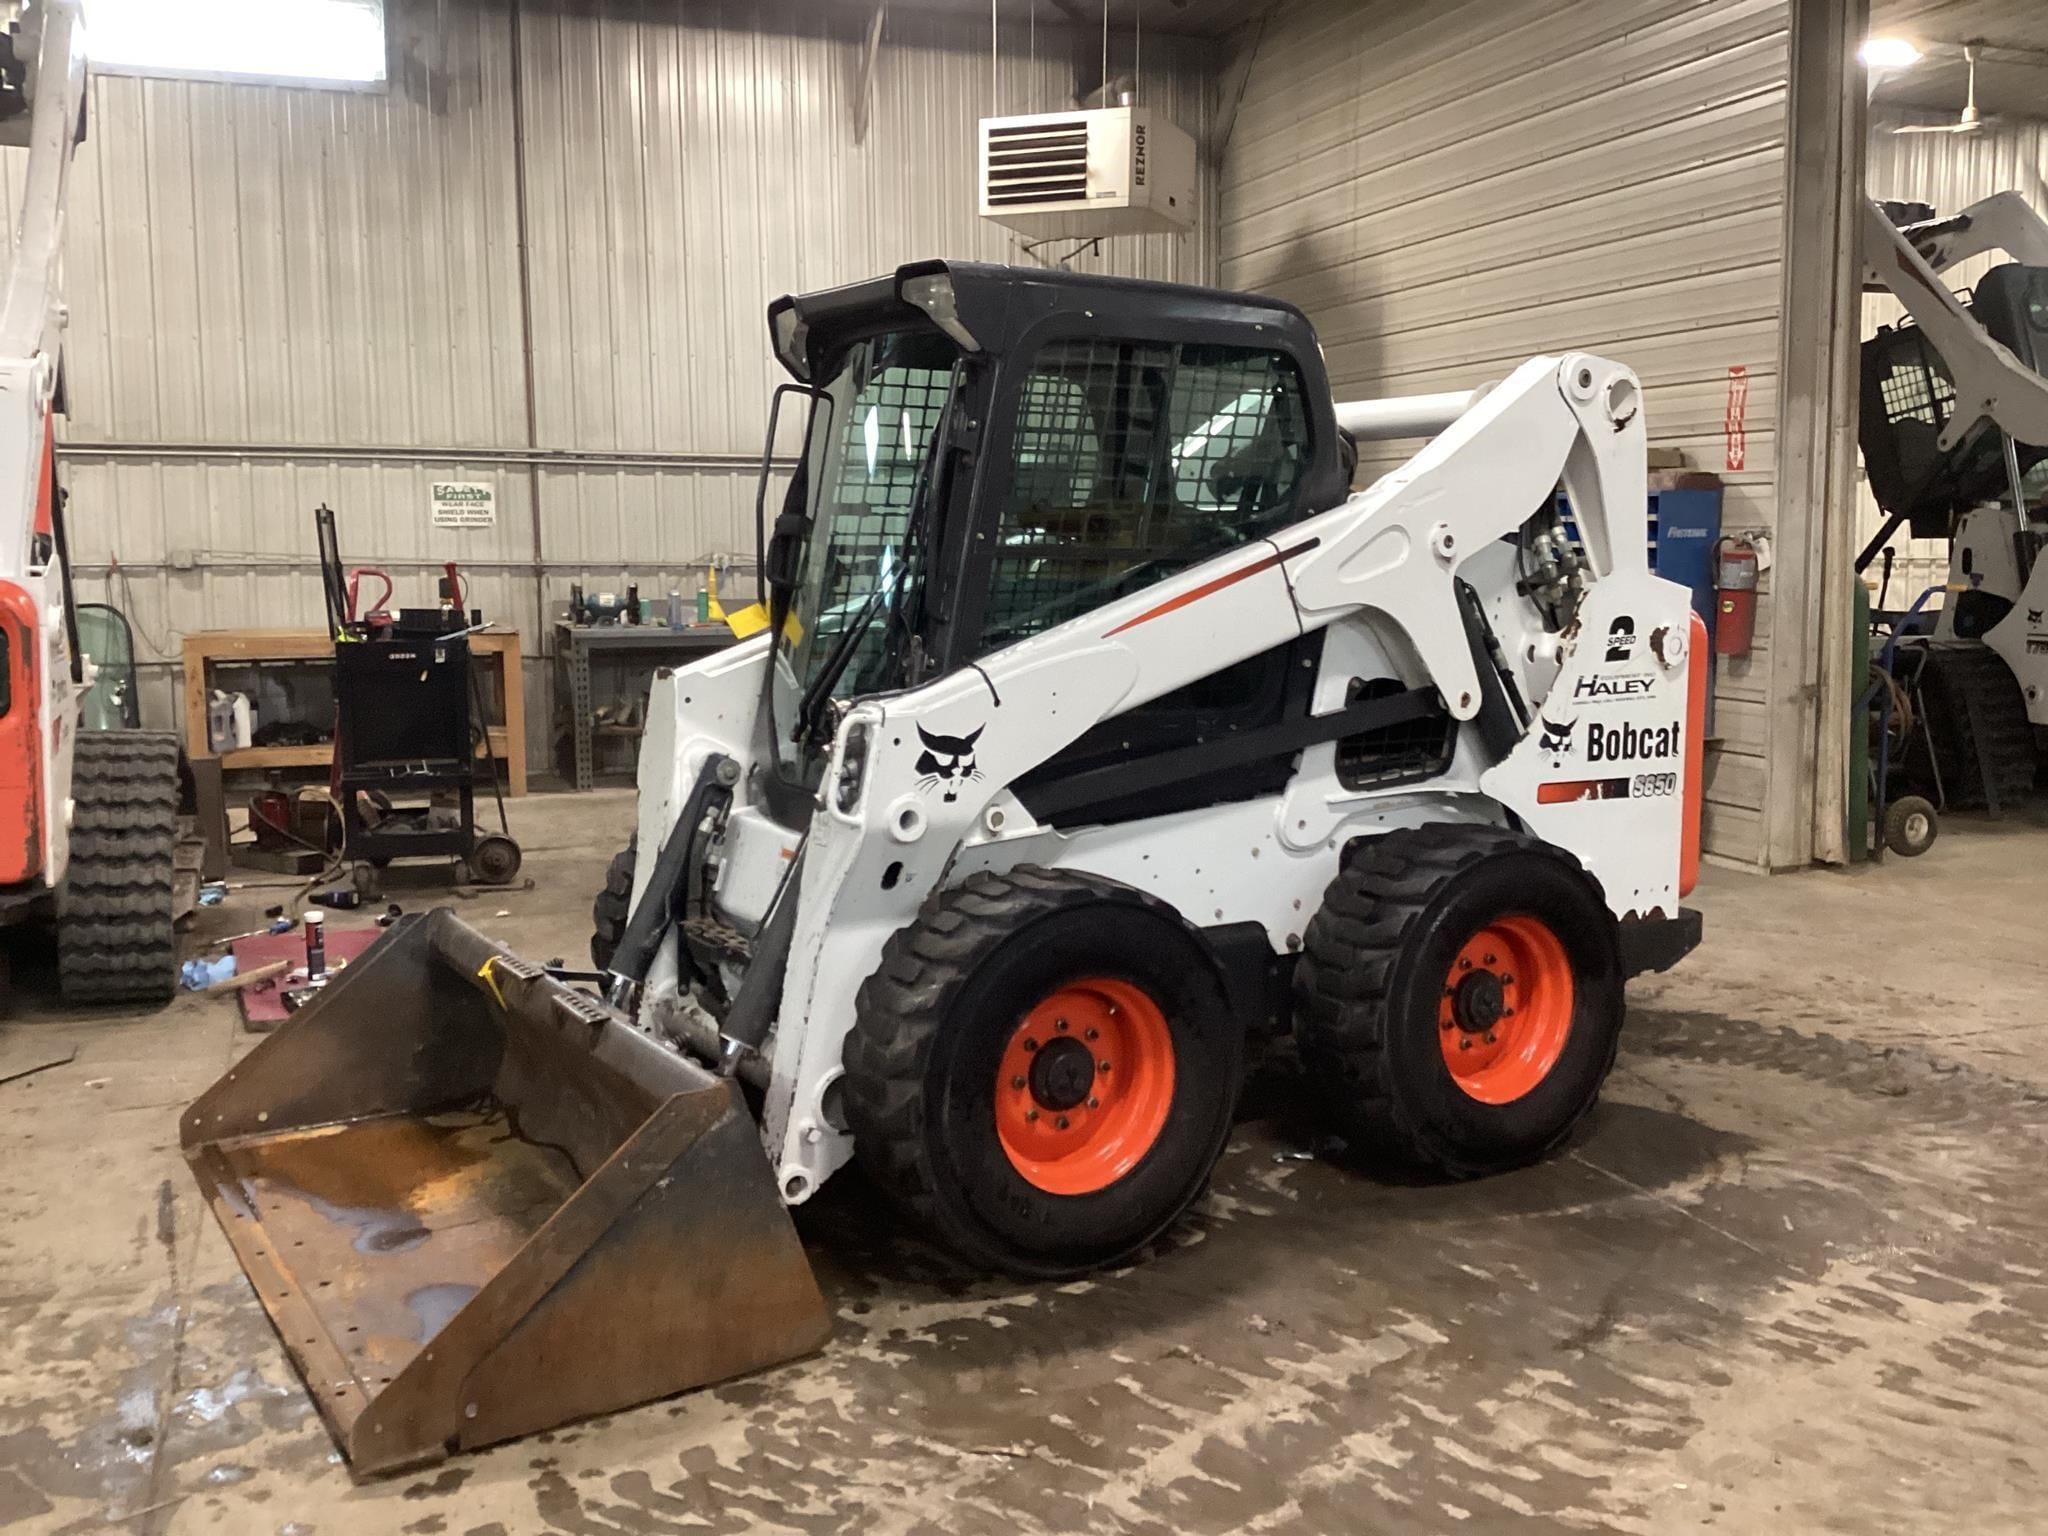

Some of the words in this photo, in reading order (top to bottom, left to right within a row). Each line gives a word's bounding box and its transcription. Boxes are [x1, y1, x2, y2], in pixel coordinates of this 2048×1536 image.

[1135, 124, 1146, 186] REZNOR
[1607, 635, 1636, 647] SPEED
[1573, 674, 1656, 698] HALEY
[1587, 720, 1680, 762] Bobcat
[1632, 771, 1677, 799] S650
